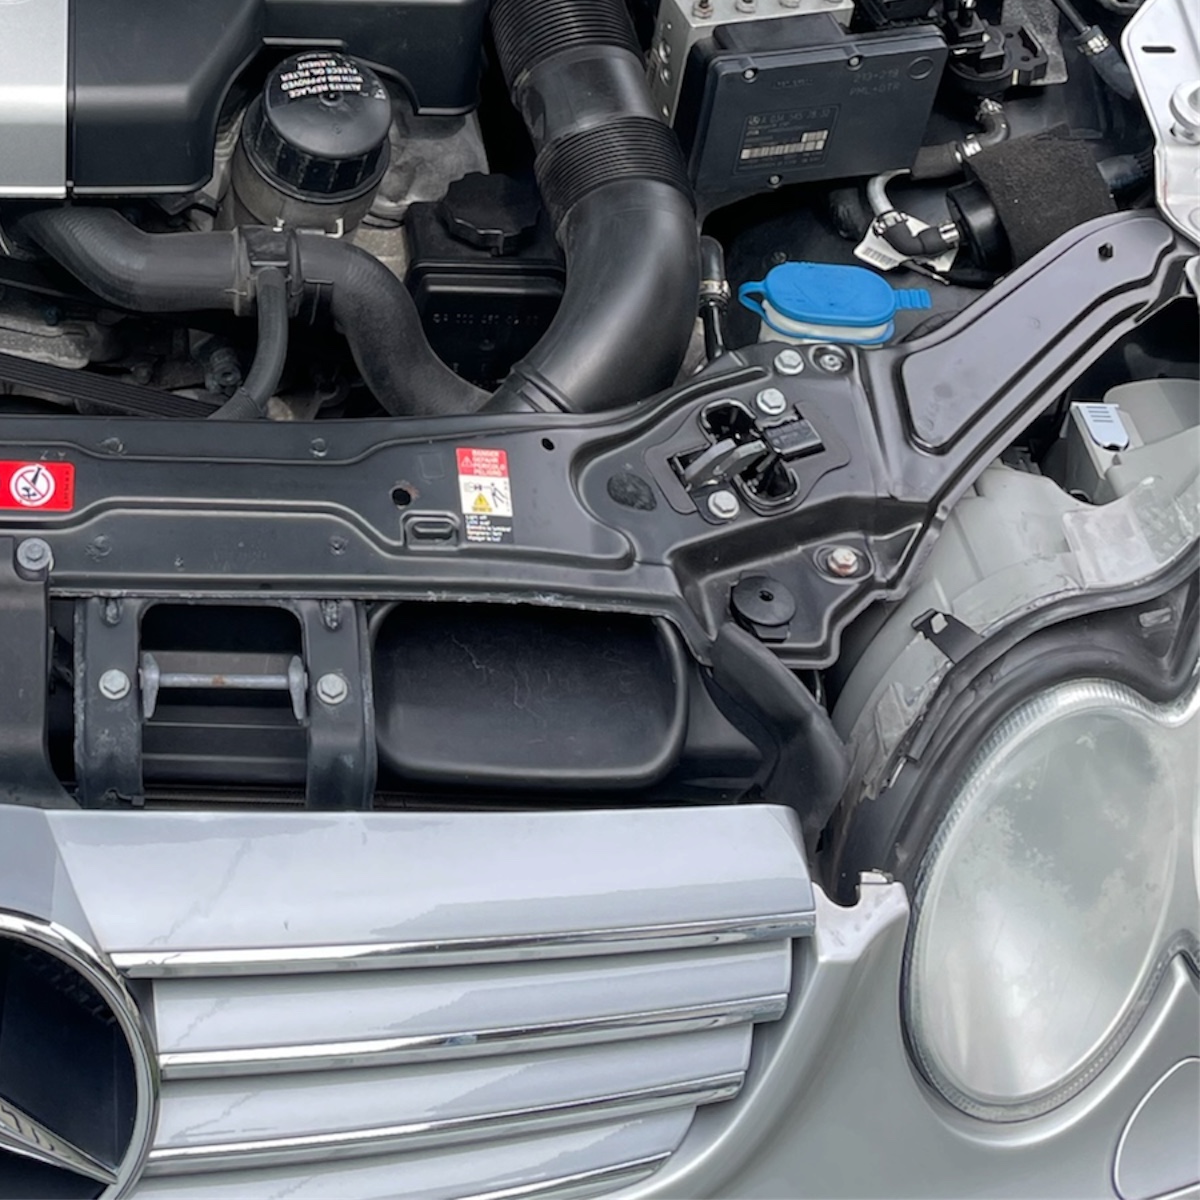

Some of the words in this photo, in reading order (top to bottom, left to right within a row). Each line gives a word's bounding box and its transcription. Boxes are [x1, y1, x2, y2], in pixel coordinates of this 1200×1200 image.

[297, 59, 337, 70] ELEMENT
[280, 69, 311, 82] FILTER
[281, 76, 327, 91] APPROVED
[329, 83, 361, 92] ALWAYS
[288, 84, 329, 99] REPLACE
